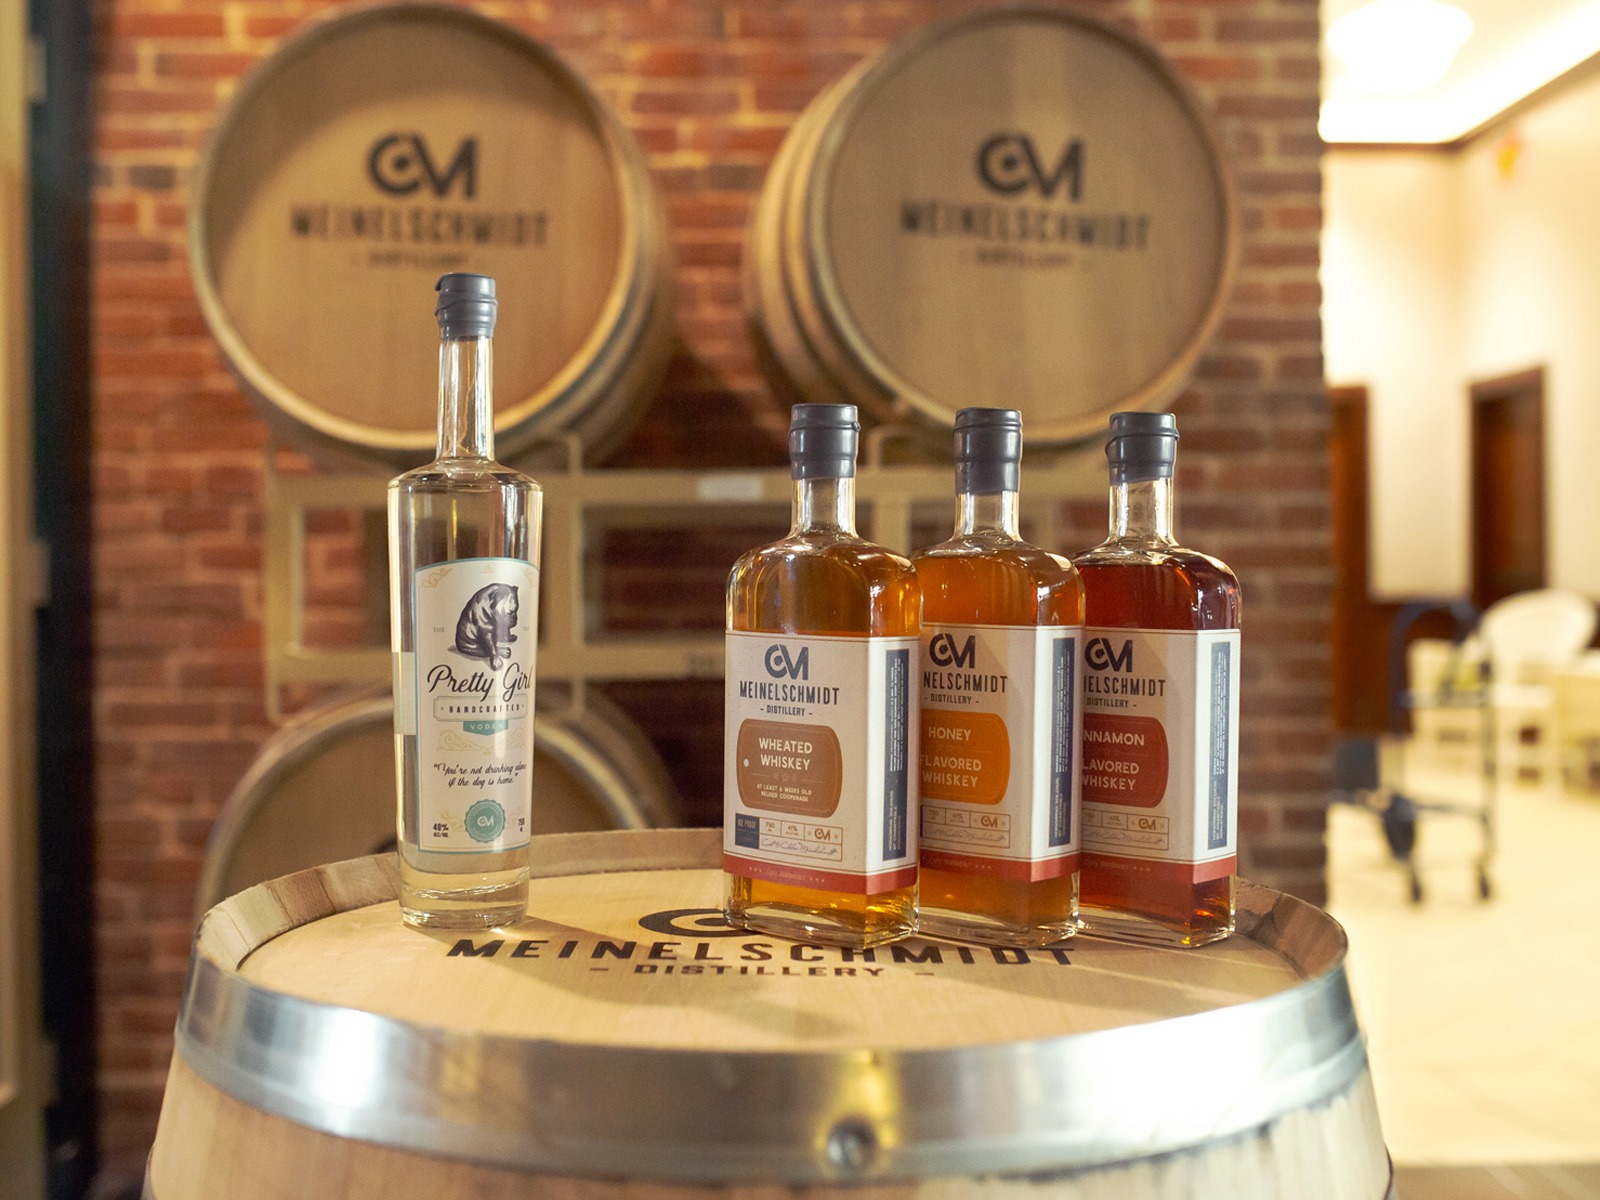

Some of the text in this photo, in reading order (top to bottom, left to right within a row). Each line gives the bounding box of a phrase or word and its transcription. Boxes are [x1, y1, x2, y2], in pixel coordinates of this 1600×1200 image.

[427, 661, 534, 702] Pretty Girl
[923, 671, 1008, 693] NELSCHMIDT
[1084, 675, 1166, 697] ELSCHMIDT
[740, 681, 840, 706] MEINELSCHMIDT
[930, 693, 972, 704] DISTILLERY
[449, 704, 521, 714] HANDCRAFTED
[1087, 697, 1129, 708] DISTILLERY
[766, 705, 806, 717] DISTILLERY
[928, 726, 971, 741] HONEY
[1084, 729, 1144, 746] NNAMON
[759, 737, 813, 754] WHEATED
[470, 766, 483, 775] not
[761, 754, 811, 771] WHISKEY
[1084, 760, 1140, 775] AVORED
[458, 777, 470, 786] the
[473, 777, 485, 789] dog
[923, 771, 979, 788] WHISKEY
[447, 939, 1075, 966] MEINELSCHMIDT
[634, 964, 885, 977] DISTILLERY
